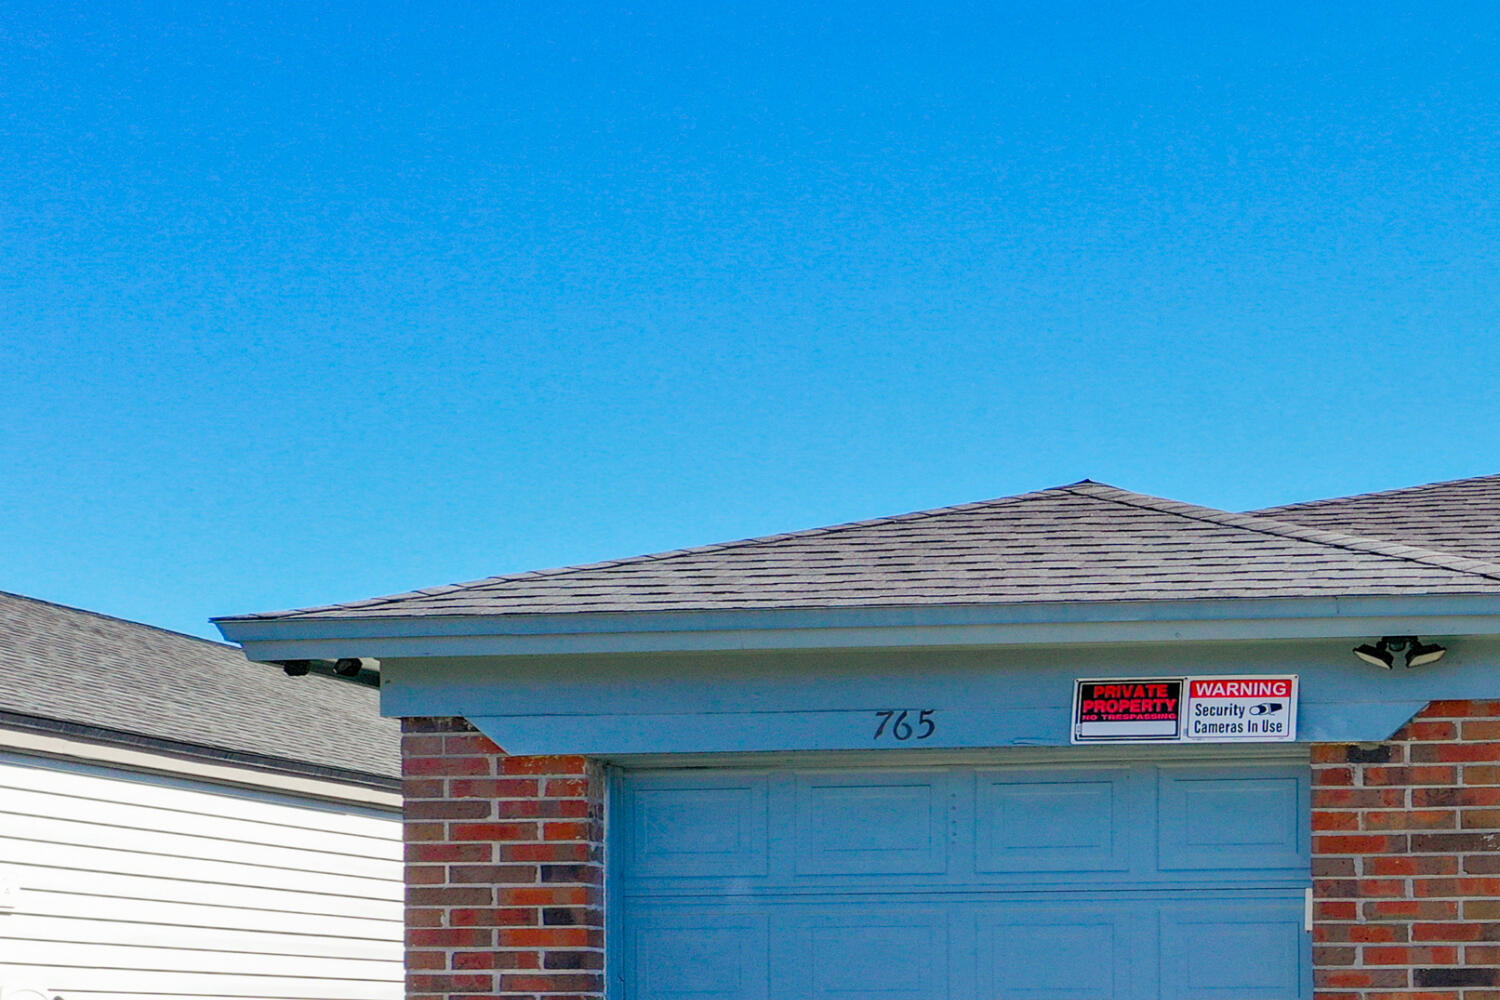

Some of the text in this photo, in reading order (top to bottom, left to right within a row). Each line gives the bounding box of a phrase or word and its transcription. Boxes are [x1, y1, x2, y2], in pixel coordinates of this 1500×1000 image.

[1094, 683, 1168, 699] PRIVATE
[1196, 682, 1287, 697] WARNING
[1082, 698, 1177, 713] PROPERTY
[1195, 702, 1246, 719] Security
[873, 709, 936, 740] 765
[1101, 713, 1177, 721] TRESPASSING
[1194, 719, 1283, 734] Cameras In Use
